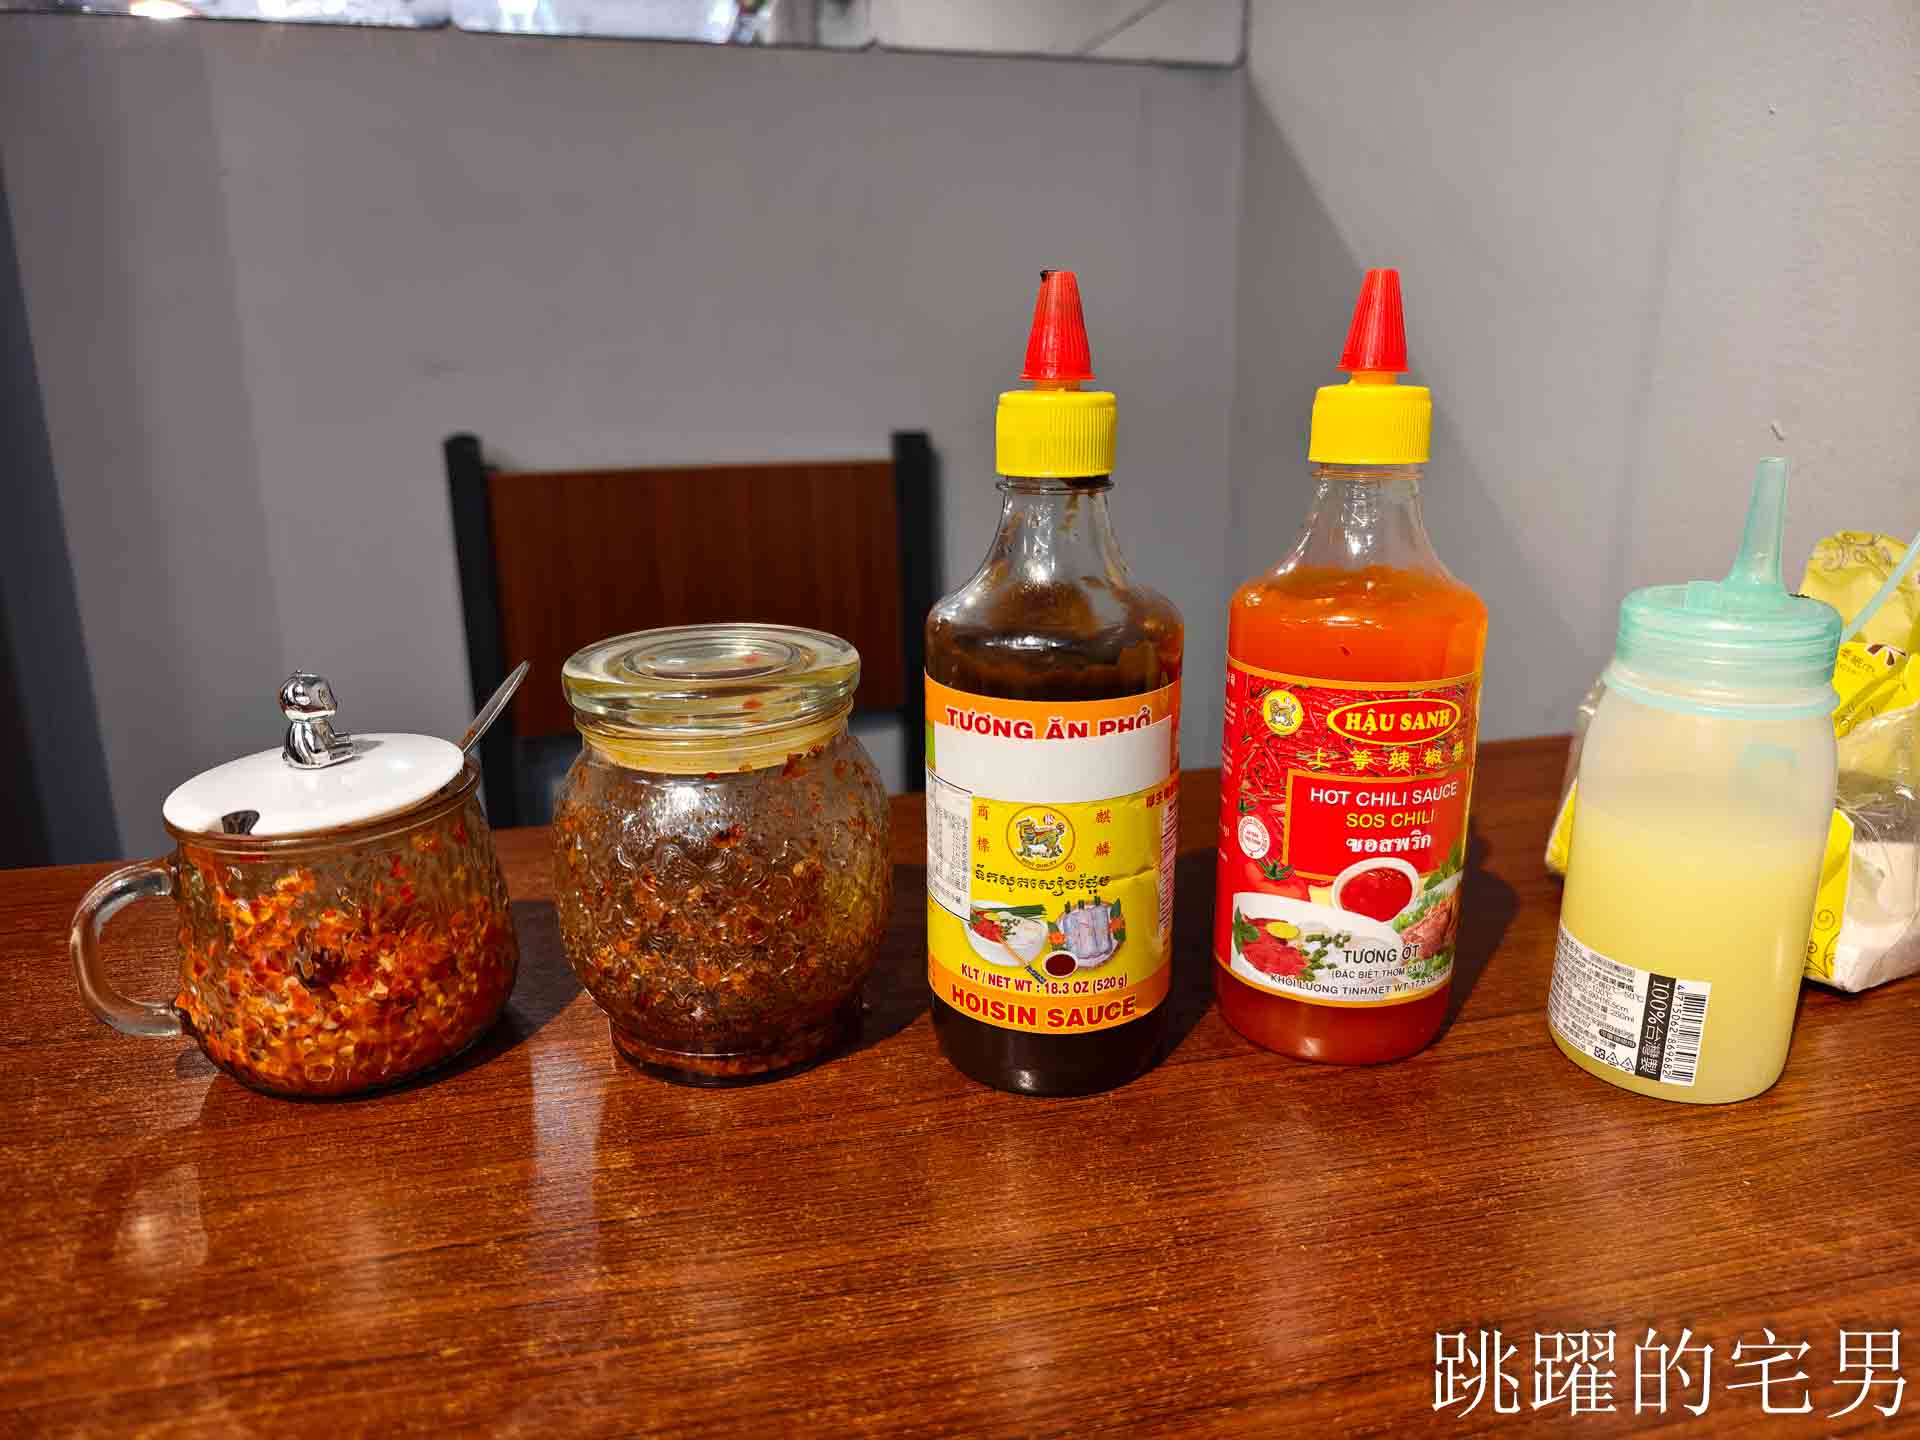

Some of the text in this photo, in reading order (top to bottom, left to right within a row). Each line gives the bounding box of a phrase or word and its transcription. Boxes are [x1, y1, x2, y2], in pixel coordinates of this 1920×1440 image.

[946, 708, 1033, 739] TƯƠNG
[1045, 717, 1088, 739] ĂN
[1345, 708, 1452, 736] HẬU SANH
[1311, 781, 1458, 807] HOT CHILI SAUCE
[1346, 809, 1434, 828] SOS CHILI
[1346, 830, 1432, 853] ซอสพริก
[1344, 947, 1398, 964] TƯƠNG
[962, 963, 980, 983] KLT
[988, 973, 1011, 989] NET
[1015, 979, 1033, 993] WT
[1044, 981, 1069, 994] 18.3
[1073, 981, 1089, 993] OZ
[1092, 977, 1116, 993] (520
[1118, 972, 1128, 990] g)
[952, 984, 1136, 1027] HOISIN SAUCE
[1639, 979, 1671, 1075] 100%台灣製
